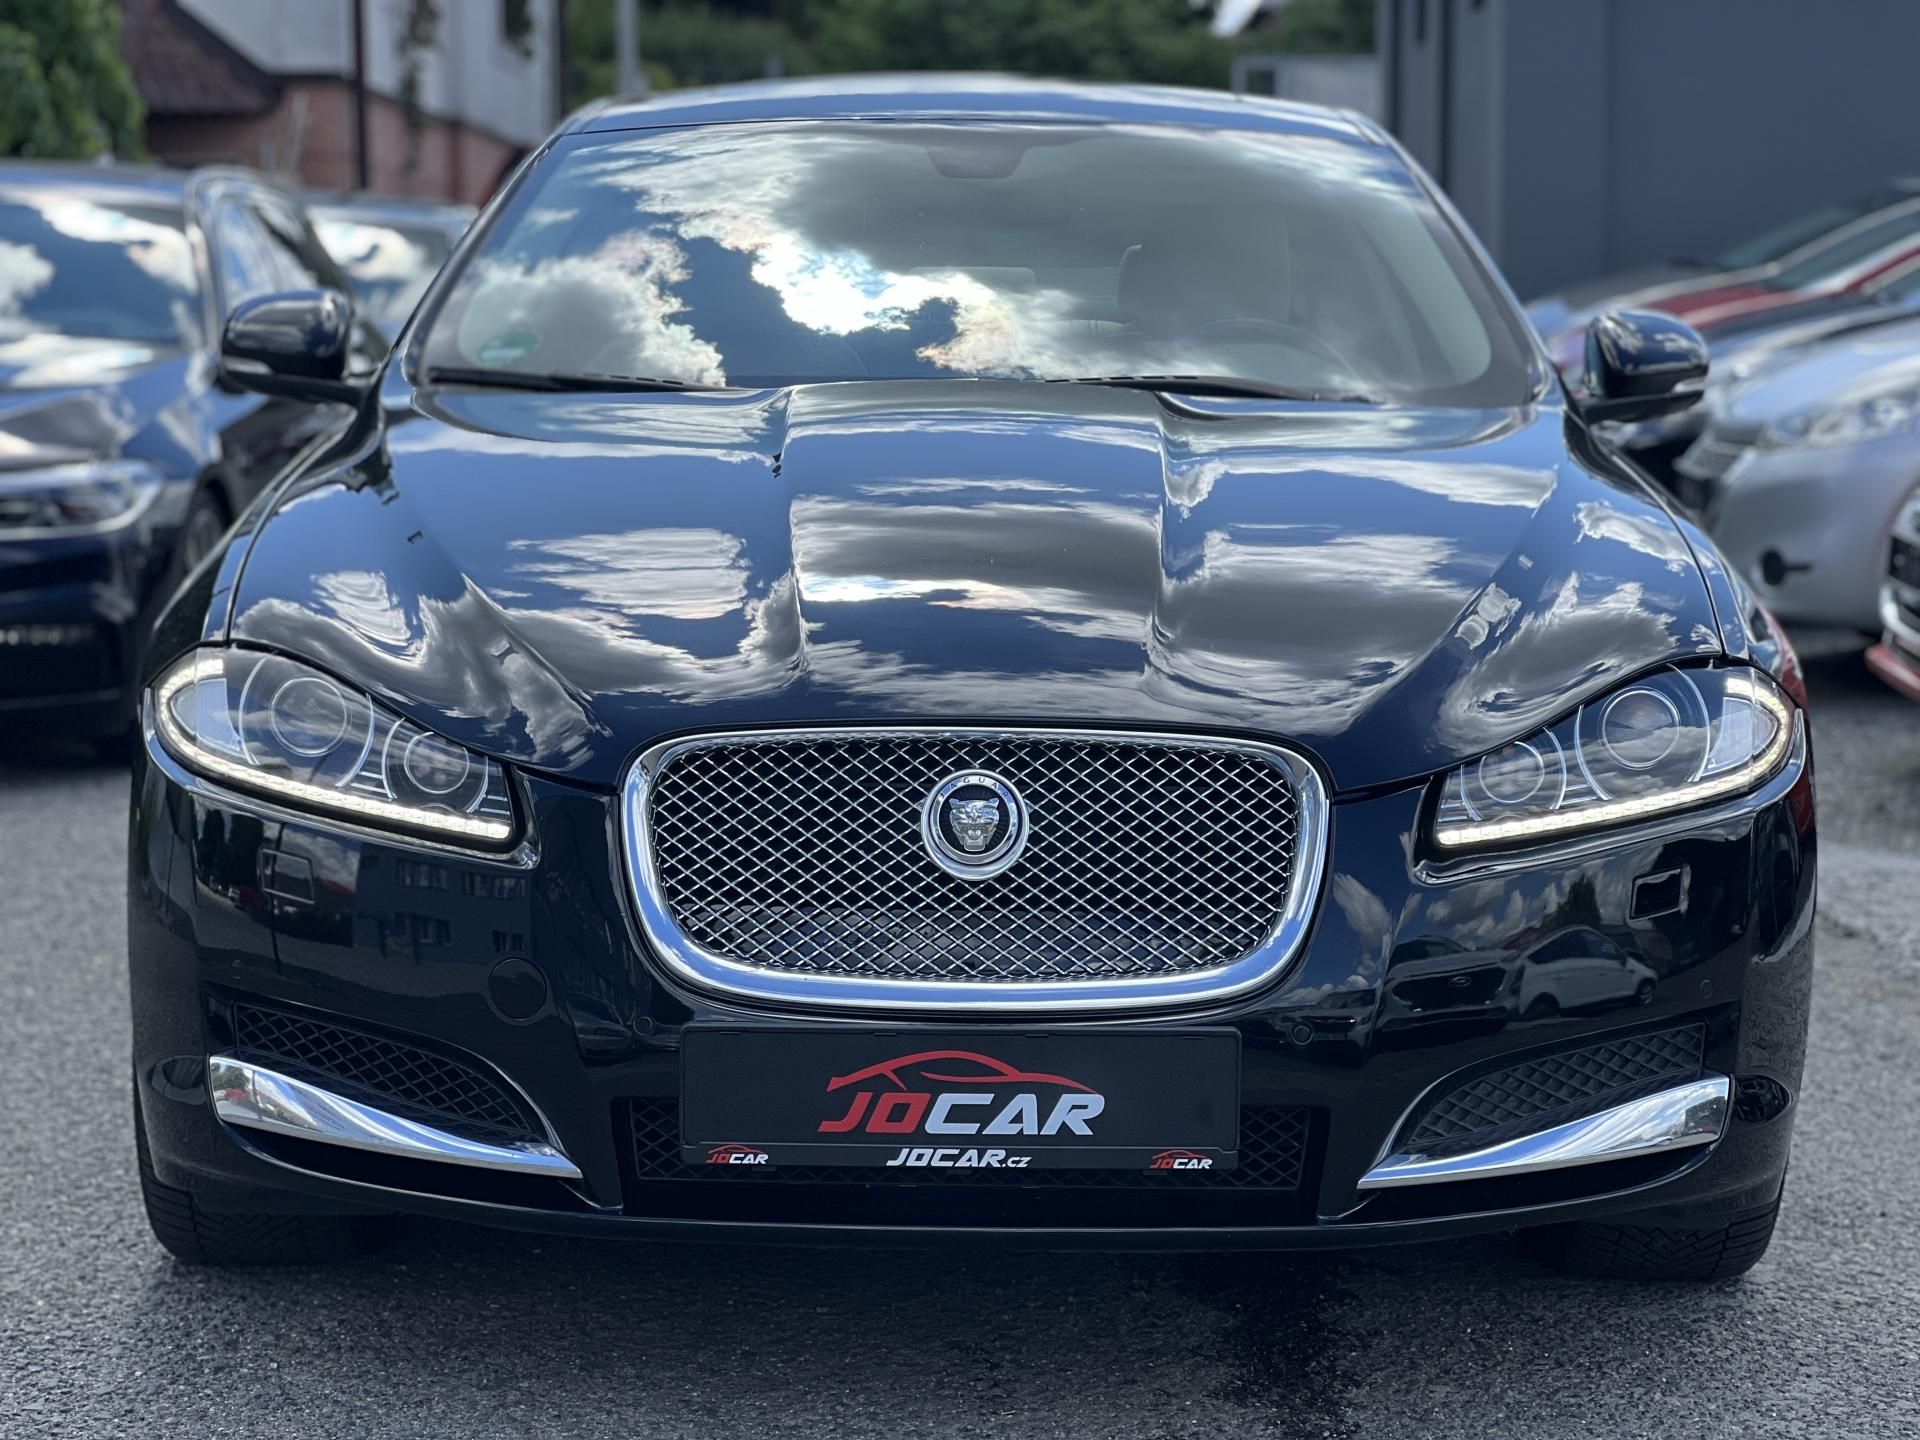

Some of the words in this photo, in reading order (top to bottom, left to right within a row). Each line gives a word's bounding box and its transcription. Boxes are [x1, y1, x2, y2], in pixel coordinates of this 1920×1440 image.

[938, 777, 1009, 798] JAGUAR
[818, 1092, 1105, 1135] JOCAR
[706, 1153, 769, 1164] JOCAR
[1150, 1157, 1213, 1169] JOCAR
